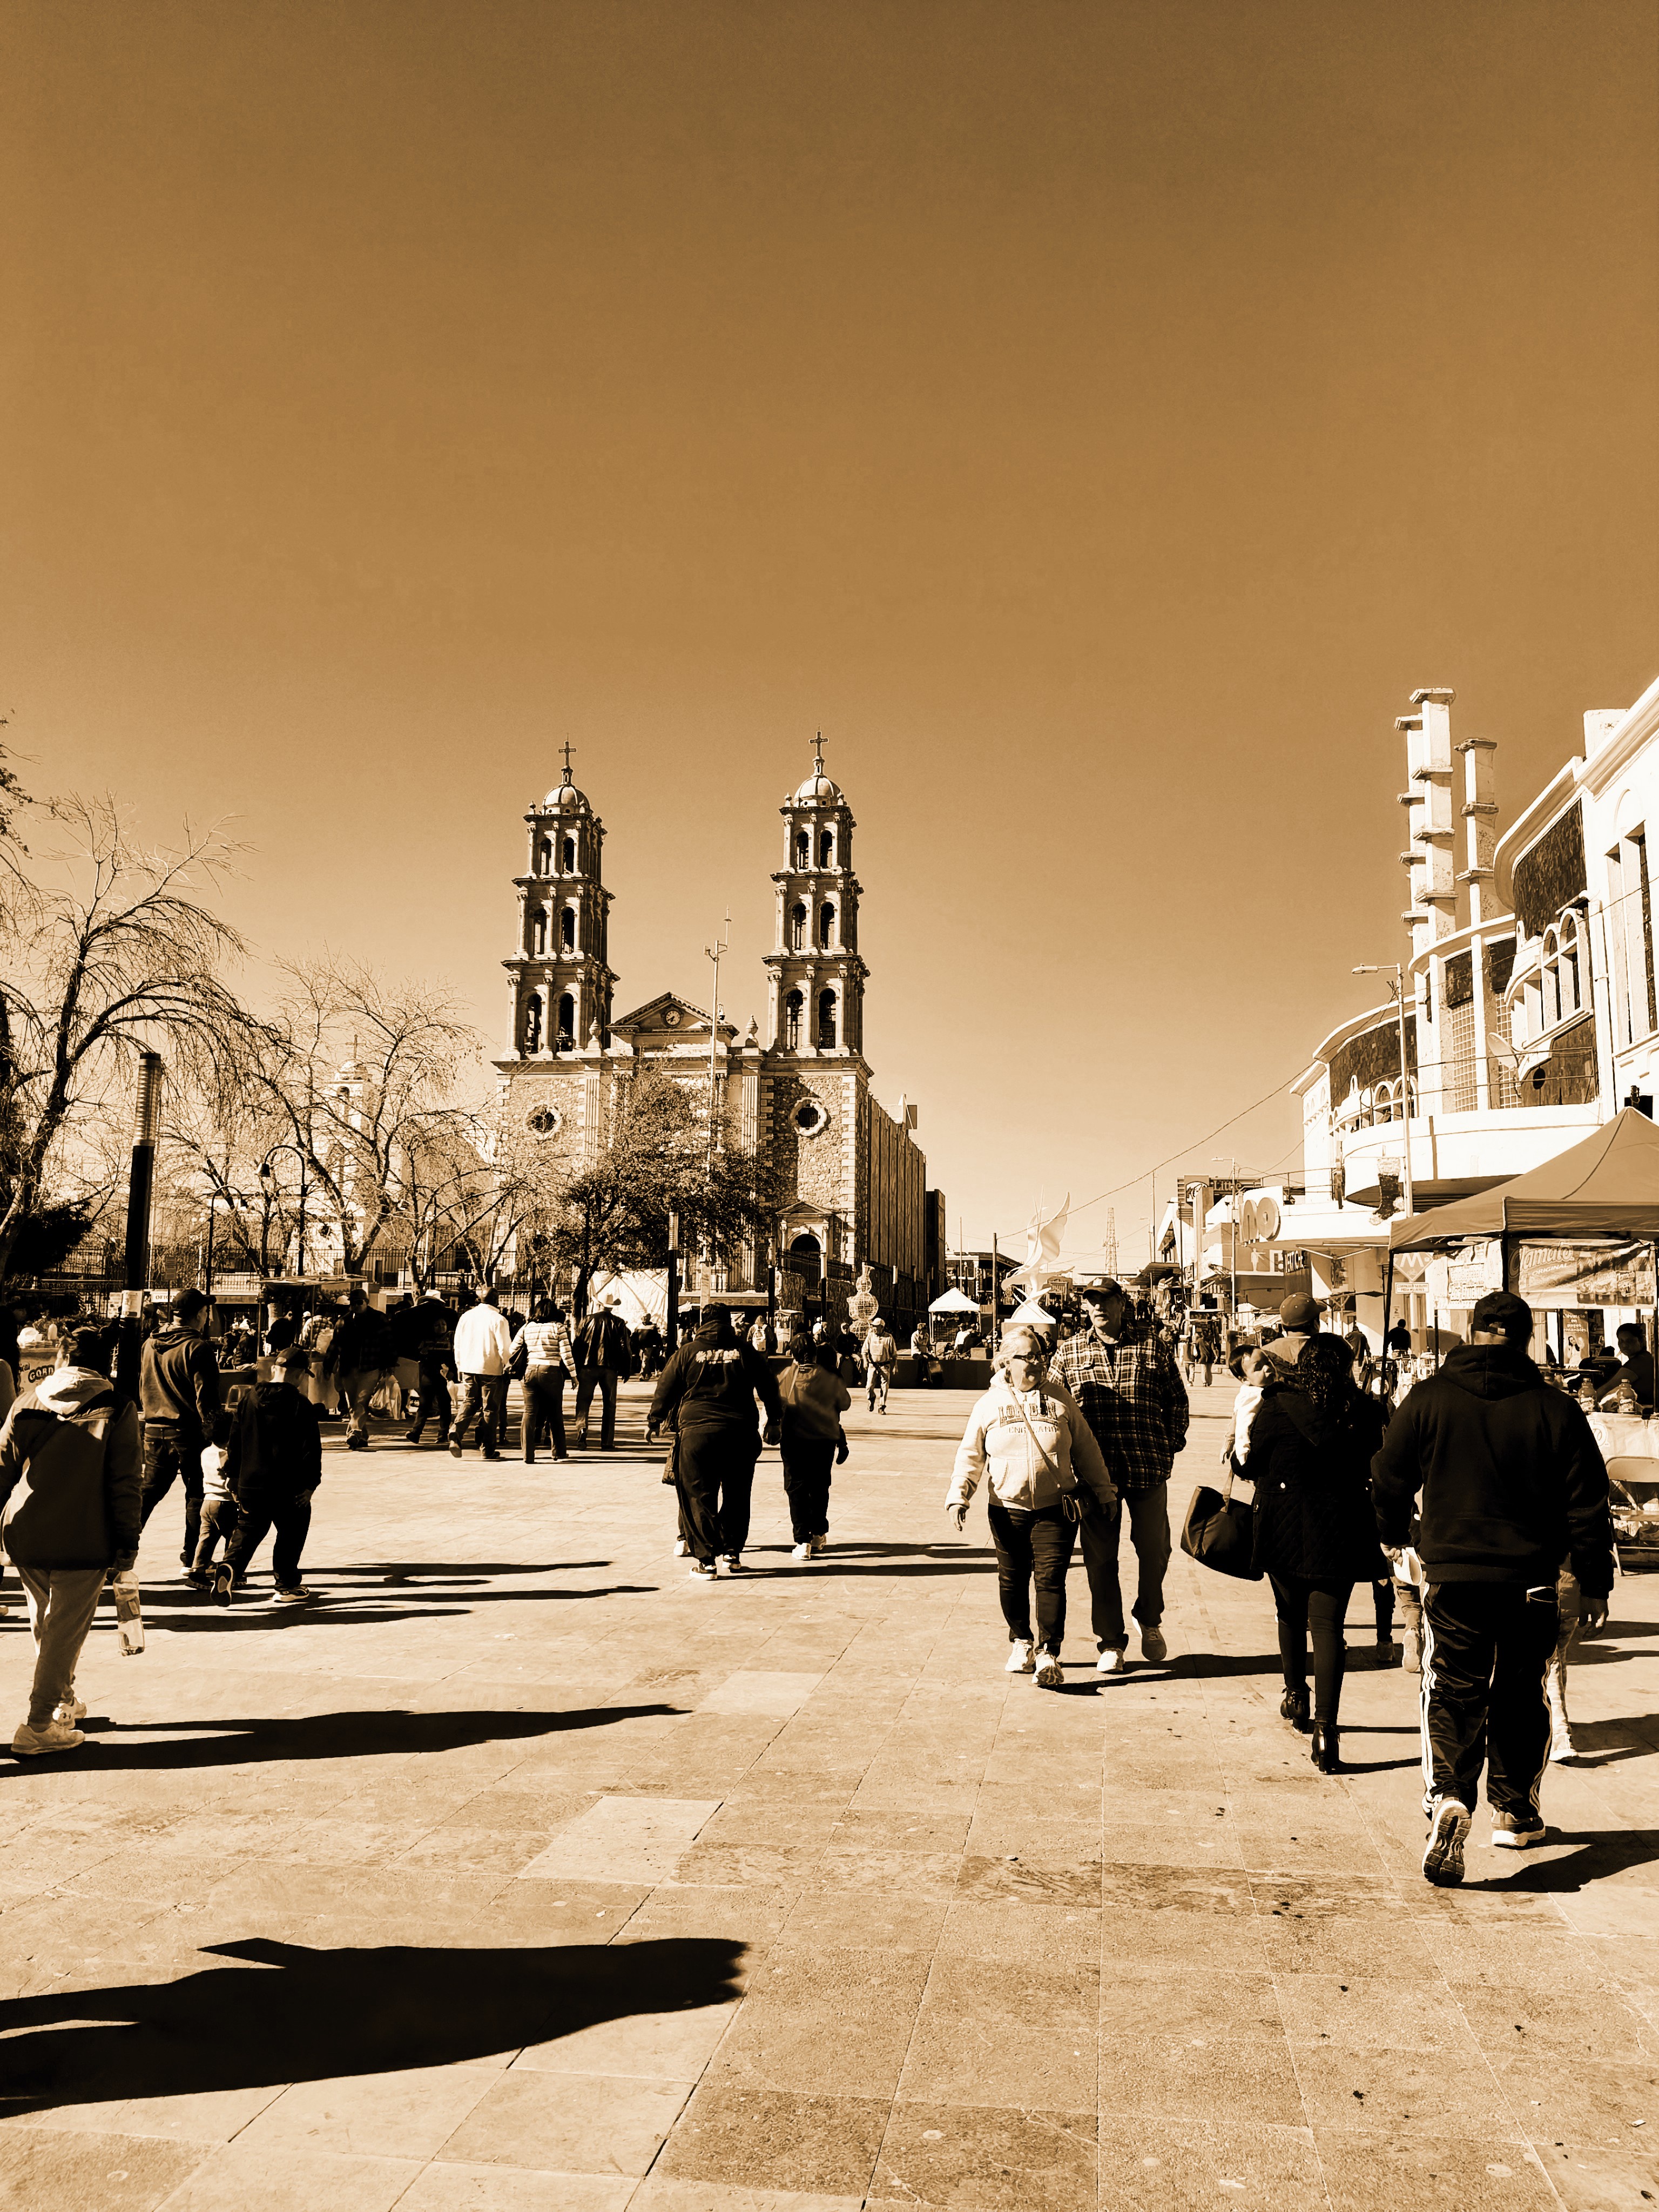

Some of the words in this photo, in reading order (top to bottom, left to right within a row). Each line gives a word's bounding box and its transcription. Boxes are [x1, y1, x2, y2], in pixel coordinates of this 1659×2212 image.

[1213, 1180, 1242, 1191] Litte
[1509, 1240, 1573, 1278] Clamato
[1532, 1263, 1569, 1276] ORIGINAL
